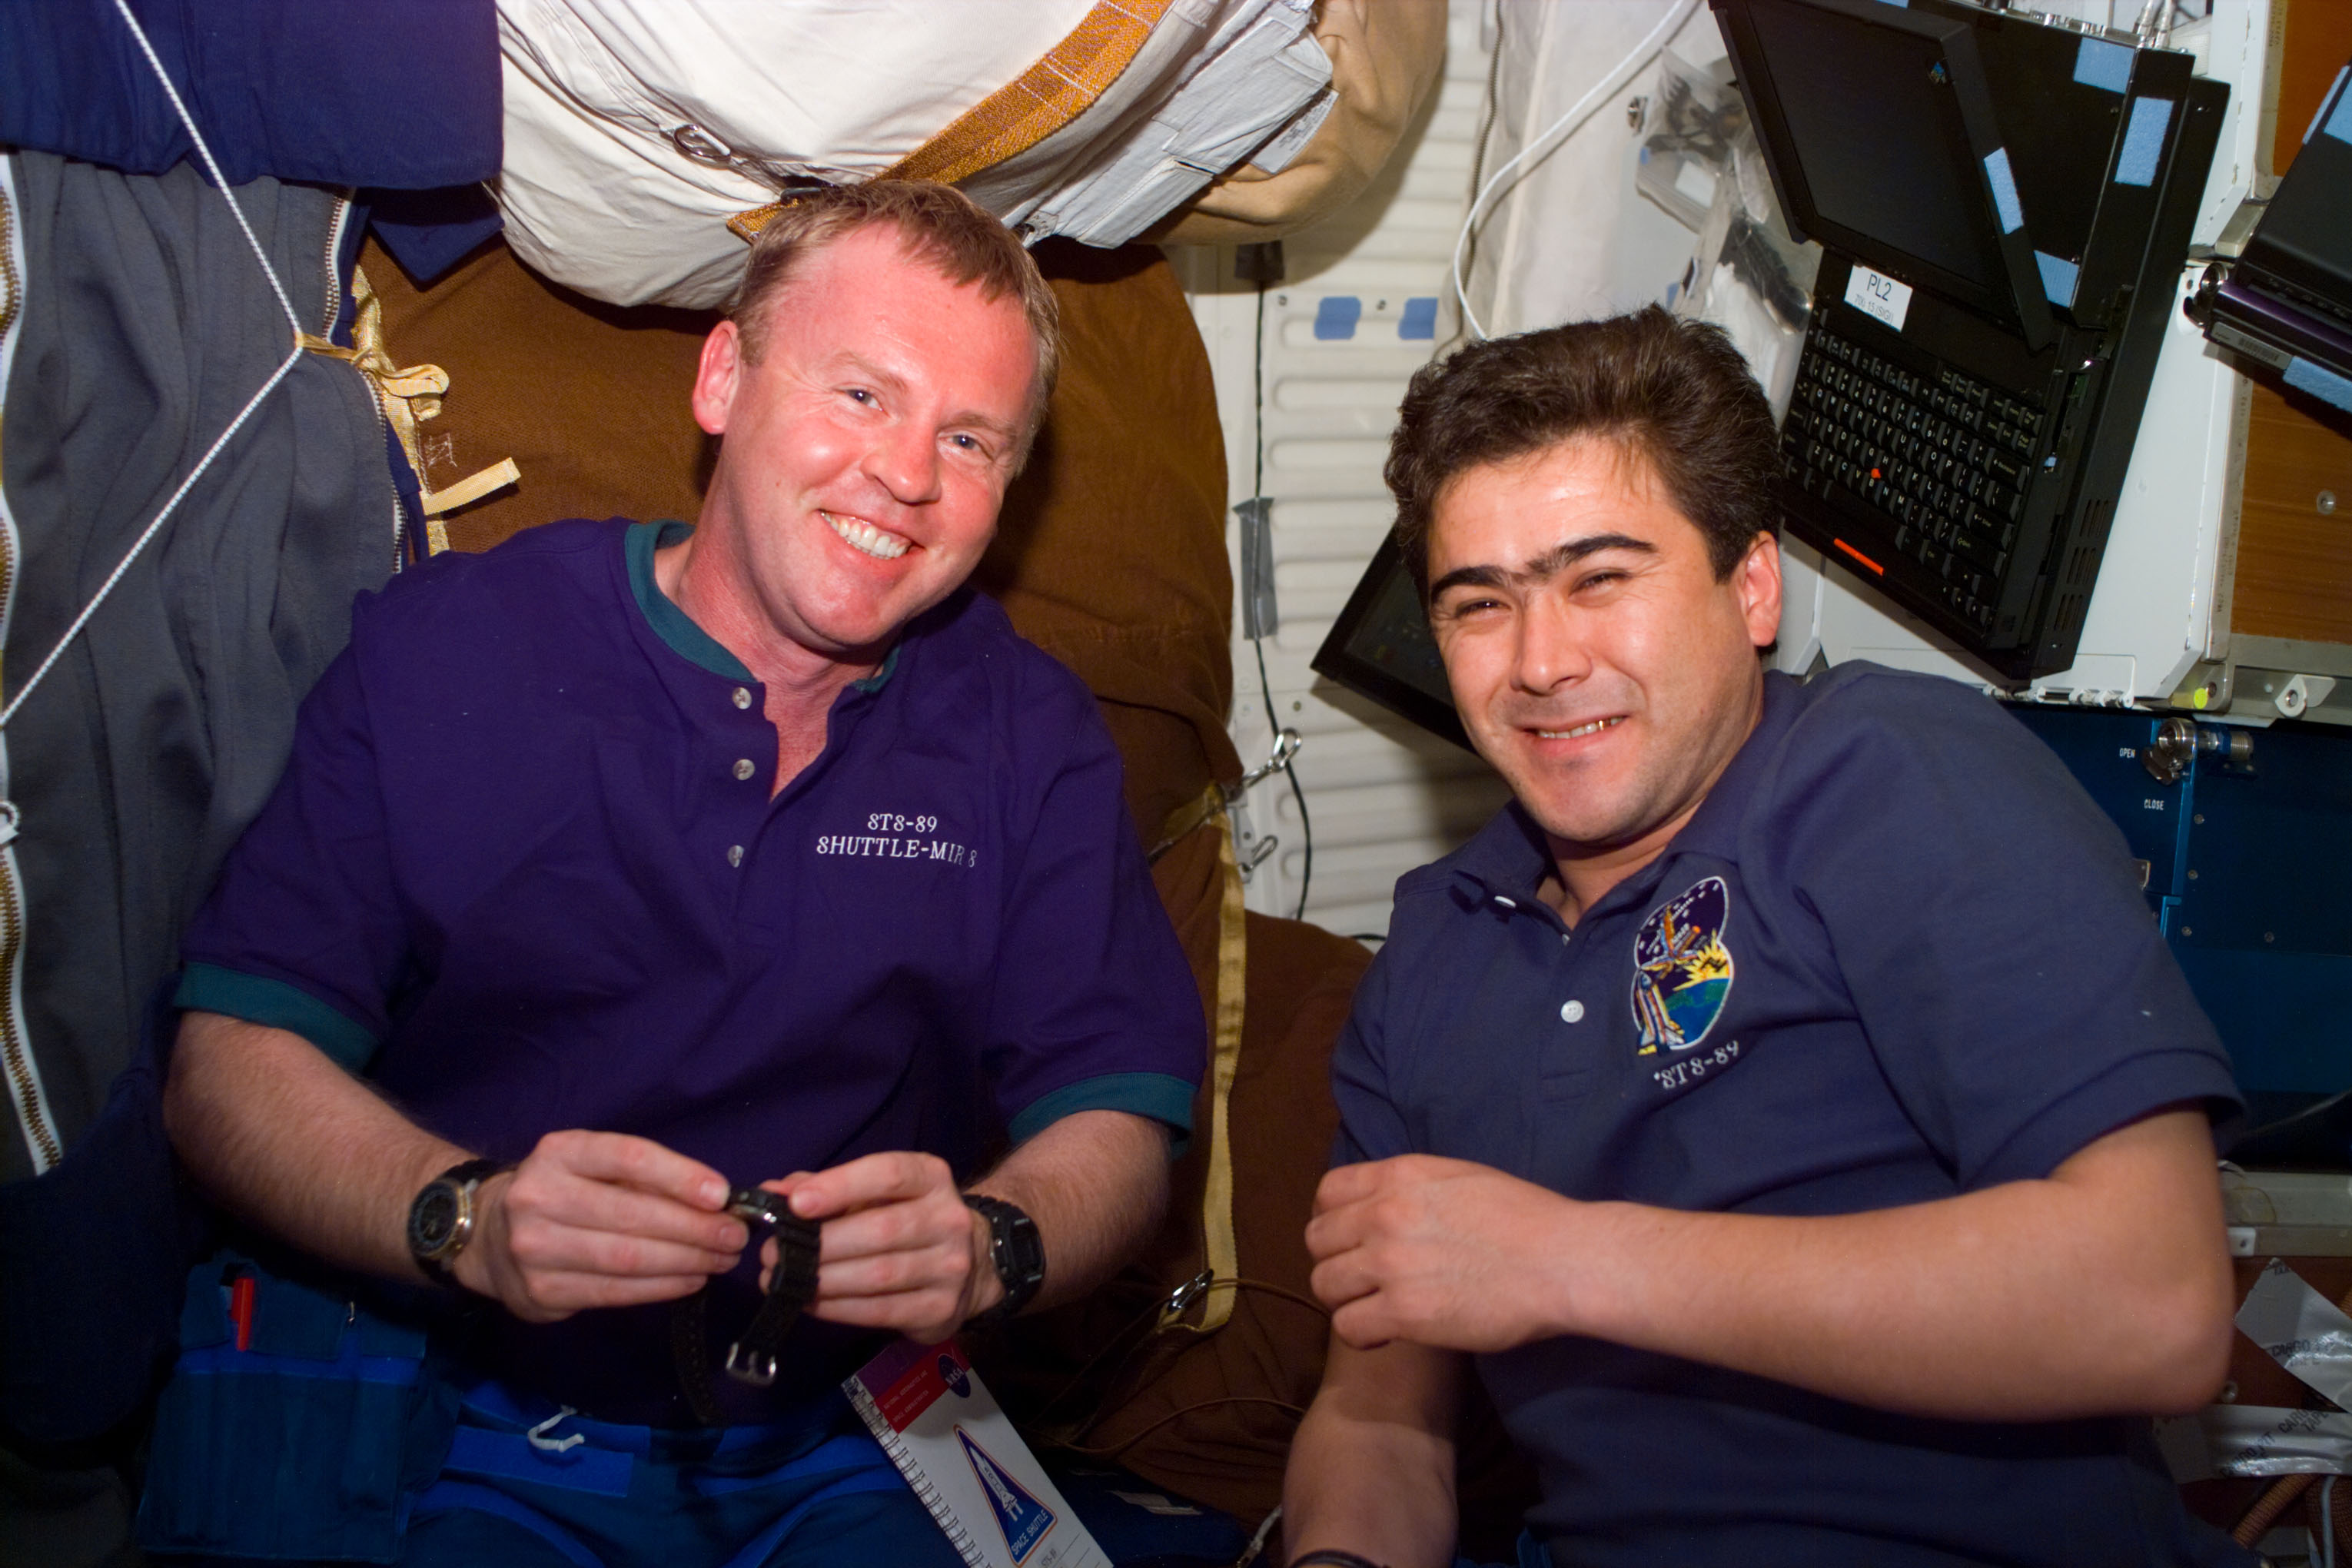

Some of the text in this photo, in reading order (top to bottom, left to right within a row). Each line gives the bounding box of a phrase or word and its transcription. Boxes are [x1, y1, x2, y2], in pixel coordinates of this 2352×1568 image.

[1866, 273, 1892, 301] PL2
[2119, 747, 2136, 759] OPEN
[2144, 799, 2164, 810] CLOSE
[867, 813, 938, 832] STS-89
[816, 835, 978, 868] SHUTTLE-MIR 8
[945, 1367, 966, 1385] NASA
[1011, 1509, 1049, 1556] SPACE SHUTTLE
